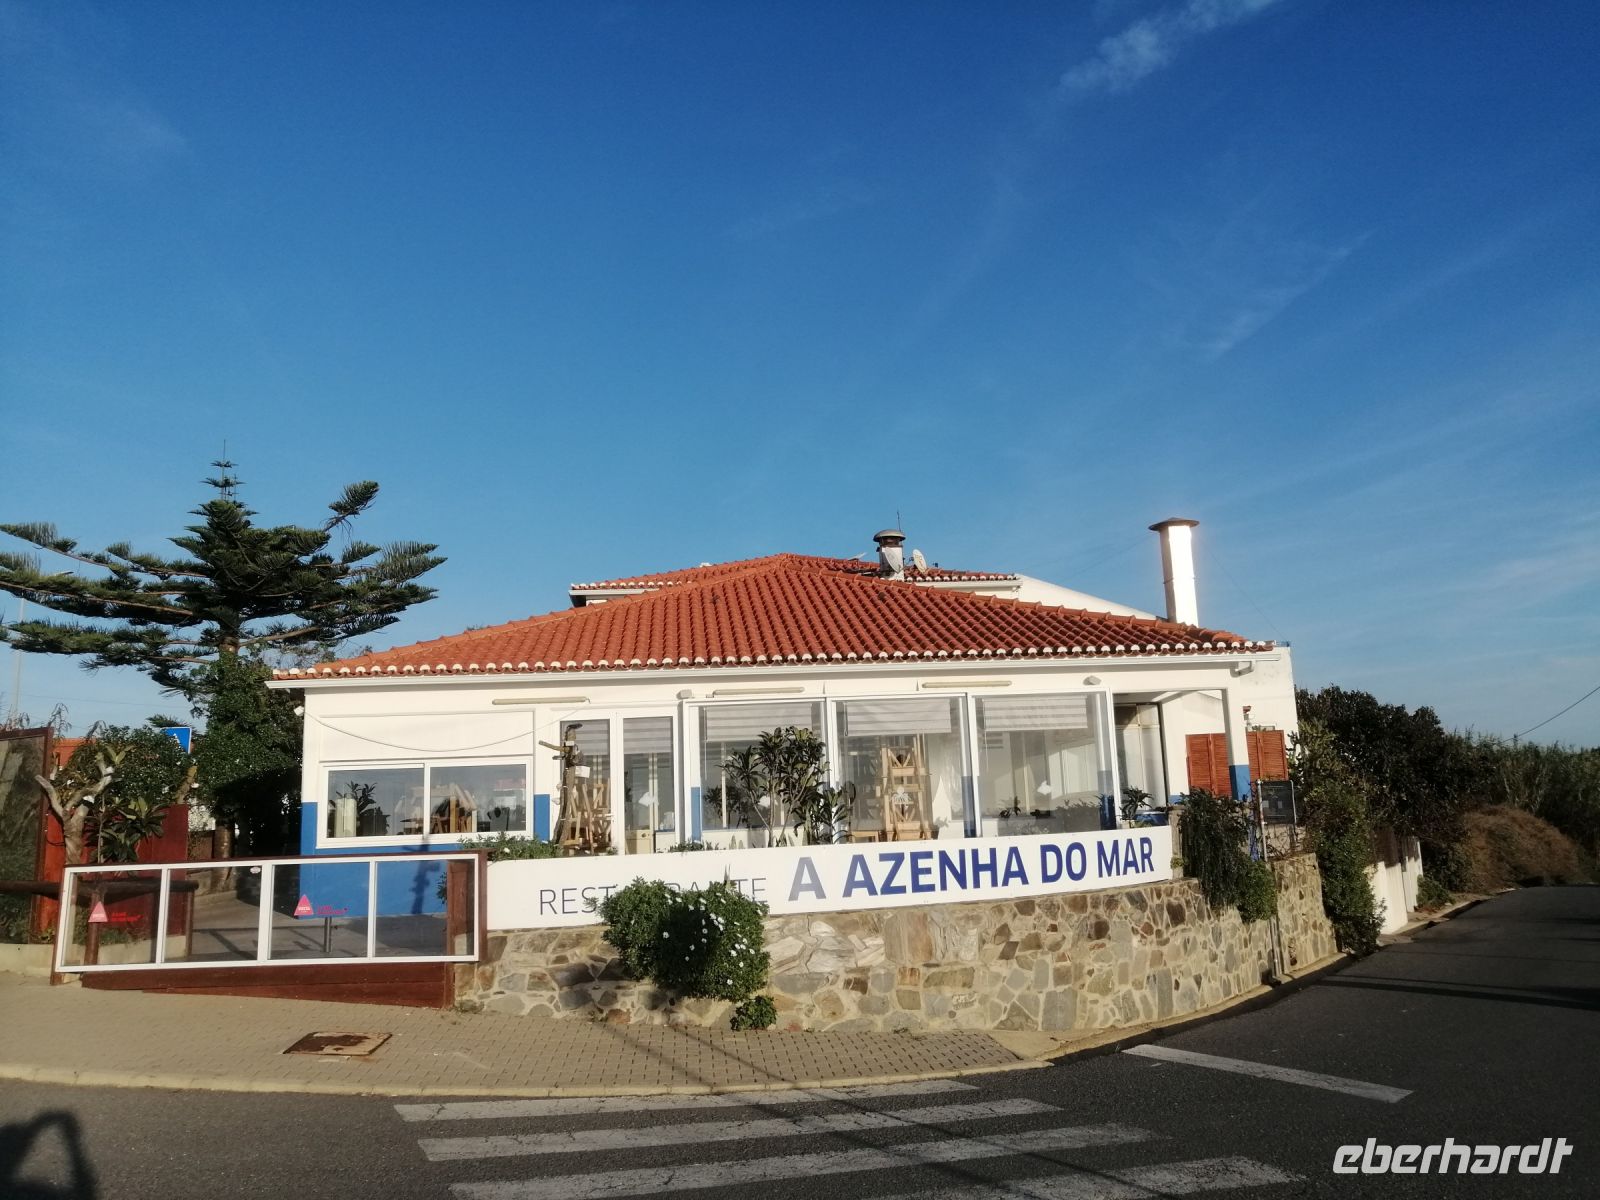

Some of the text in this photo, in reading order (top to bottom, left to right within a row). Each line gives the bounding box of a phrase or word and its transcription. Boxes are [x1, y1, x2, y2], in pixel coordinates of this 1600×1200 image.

[788, 856, 827, 901] A
[842, 846, 1029, 898] AZENHA
[1040, 842, 1087, 883] DO
[1097, 836, 1155, 878] MAR
